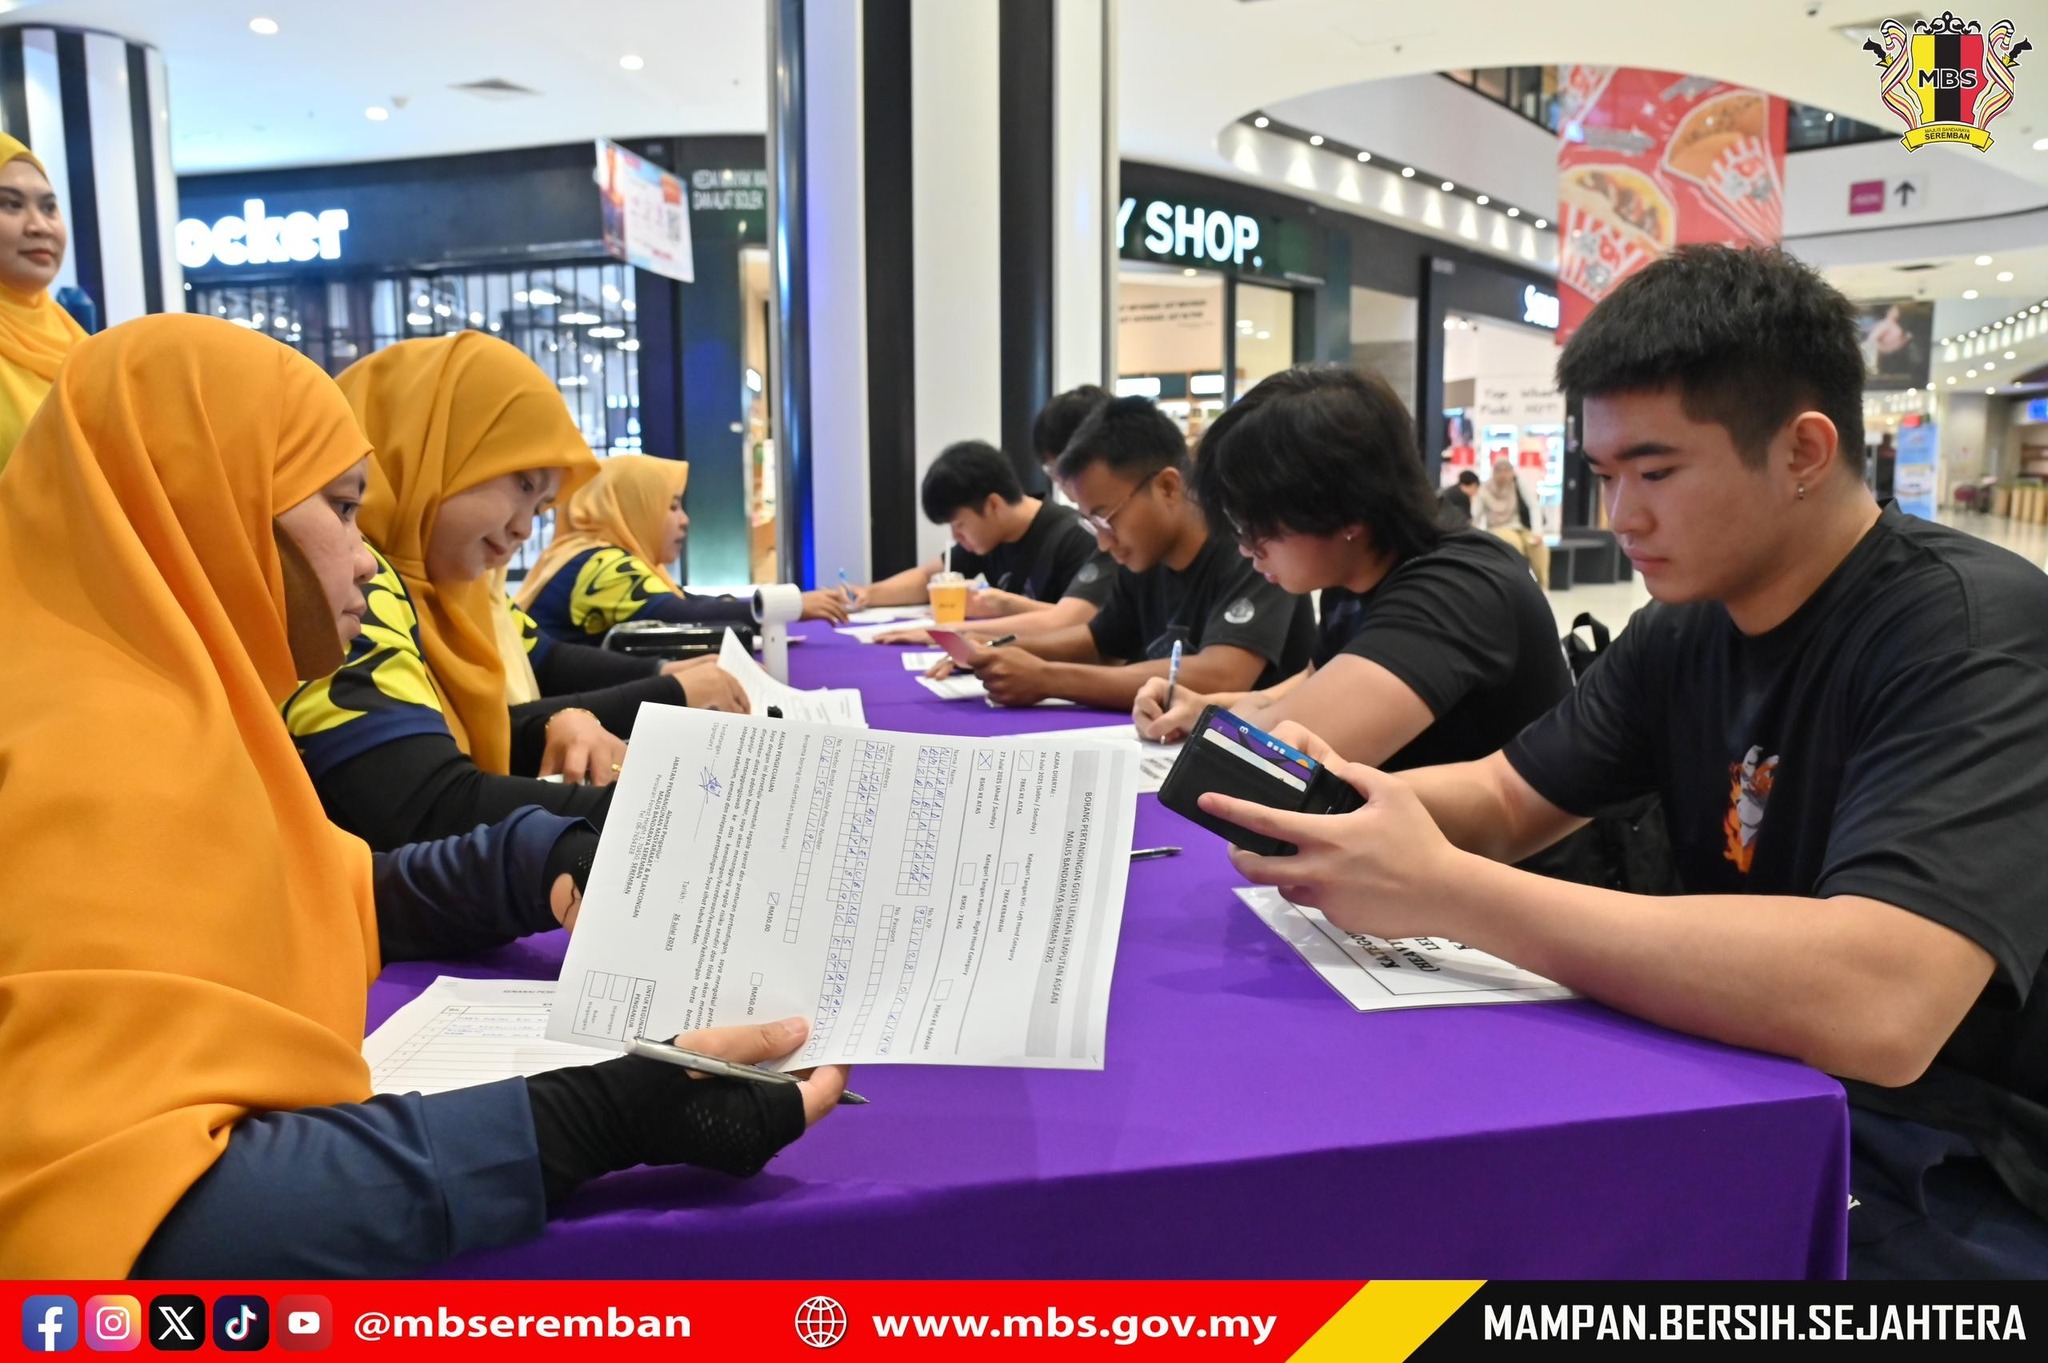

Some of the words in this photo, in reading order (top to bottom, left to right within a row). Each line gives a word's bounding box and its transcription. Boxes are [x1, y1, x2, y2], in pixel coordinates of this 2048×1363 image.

[1145, 201, 1263, 267] SHOP.
[768, 729, 777, 742] Saya
[776, 730, 786, 750] AKUAN
[763, 743, 774, 764] dengan
[1052, 751, 1060, 769] ACARA
[668, 756, 680, 780] JABATAN
[766, 750, 782, 792] PENGECUALIAN
[754, 773, 768, 799] bersetuju
[978, 777, 986, 791] 85KG
[653, 790, 664, 810] MAJLIS
[656, 782, 673, 826] PEMBANGUNAN
[722, 802, 730, 813] dan
[787, 783, 800, 812] disertakan
[974, 800, 982, 814] ATAS
[1081, 791, 1092, 823] BORANG
[662, 810, 673, 830] Alamat
[737, 818, 746, 831] saya
[748, 800, 762, 829] mematuhi
[644, 810, 659, 846] BANDARAYA
[726, 826, 735, 838] atas
[645, 827, 661, 866] MASYARAKAT
[653, 831, 667, 859] Penganjur
[734, 833, 743, 847] akan
[1063, 830, 1074, 856] MAJLIS
[635, 846, 649, 879] SEREMBAN
[1072, 824, 1088, 881] PERTANDINGAN
[982, 853, 992, 876] Kategori
[1023, 852, 1033, 876] Kategori
[623, 862, 638, 894] SEREMBAN
[703, 876, 713, 890] Saya
[737, 870, 746, 881] dan
[1056, 856, 1070, 903] BANDARAYA
[631, 874, 649, 918] PELANCONGAN
[678, 880, 689, 900] Tarikh
[978, 878, 988, 898] Tangan
[1002, 888, 1010, 903] 78KG
[1020, 876, 1029, 896] Tangan
[1069, 882, 1080, 904] GUSTI
[729, 882, 743, 912] peraturan
[958, 894, 967, 910] 85KG
[975, 898, 984, 916] Kanan
[673, 913, 681, 921] 26
[696, 906, 706, 923] tubuh
[763, 905, 775, 932] RM30.00
[955, 914, 964, 929] 71KG
[996, 904, 1007, 932] KEBAWAH
[1015, 910, 1024, 920] Left
[1048, 904, 1063, 945] SEREMBAN
[1063, 905, 1076, 935] LENGAN
[669, 922, 678, 935] Julai
[888, 918, 898, 942] Passport
[971, 920, 980, 935] Right
[1013, 921, 1022, 936] Hand
[665, 936, 675, 951] 2025
[969, 936, 977, 950] Hand
[1007, 937, 1018, 961] Category
[708, 950, 718, 962] dan
[962, 951, 974, 975] Category
[1044, 946, 1055, 963] 2025
[1055, 936, 1070, 976] JEMPUTAN
[715, 958, 725, 973] saya
[642, 984, 653, 1004] UNTUK
[688, 985, 698, 1003] harta
[700, 981, 710, 998] akan
[1049, 977, 1061, 1004] ASEAN
[626, 993, 641, 1027] PENGANJUR
[745, 986, 758, 1015] RM50.00
[682, 1008, 693, 1029] benda
